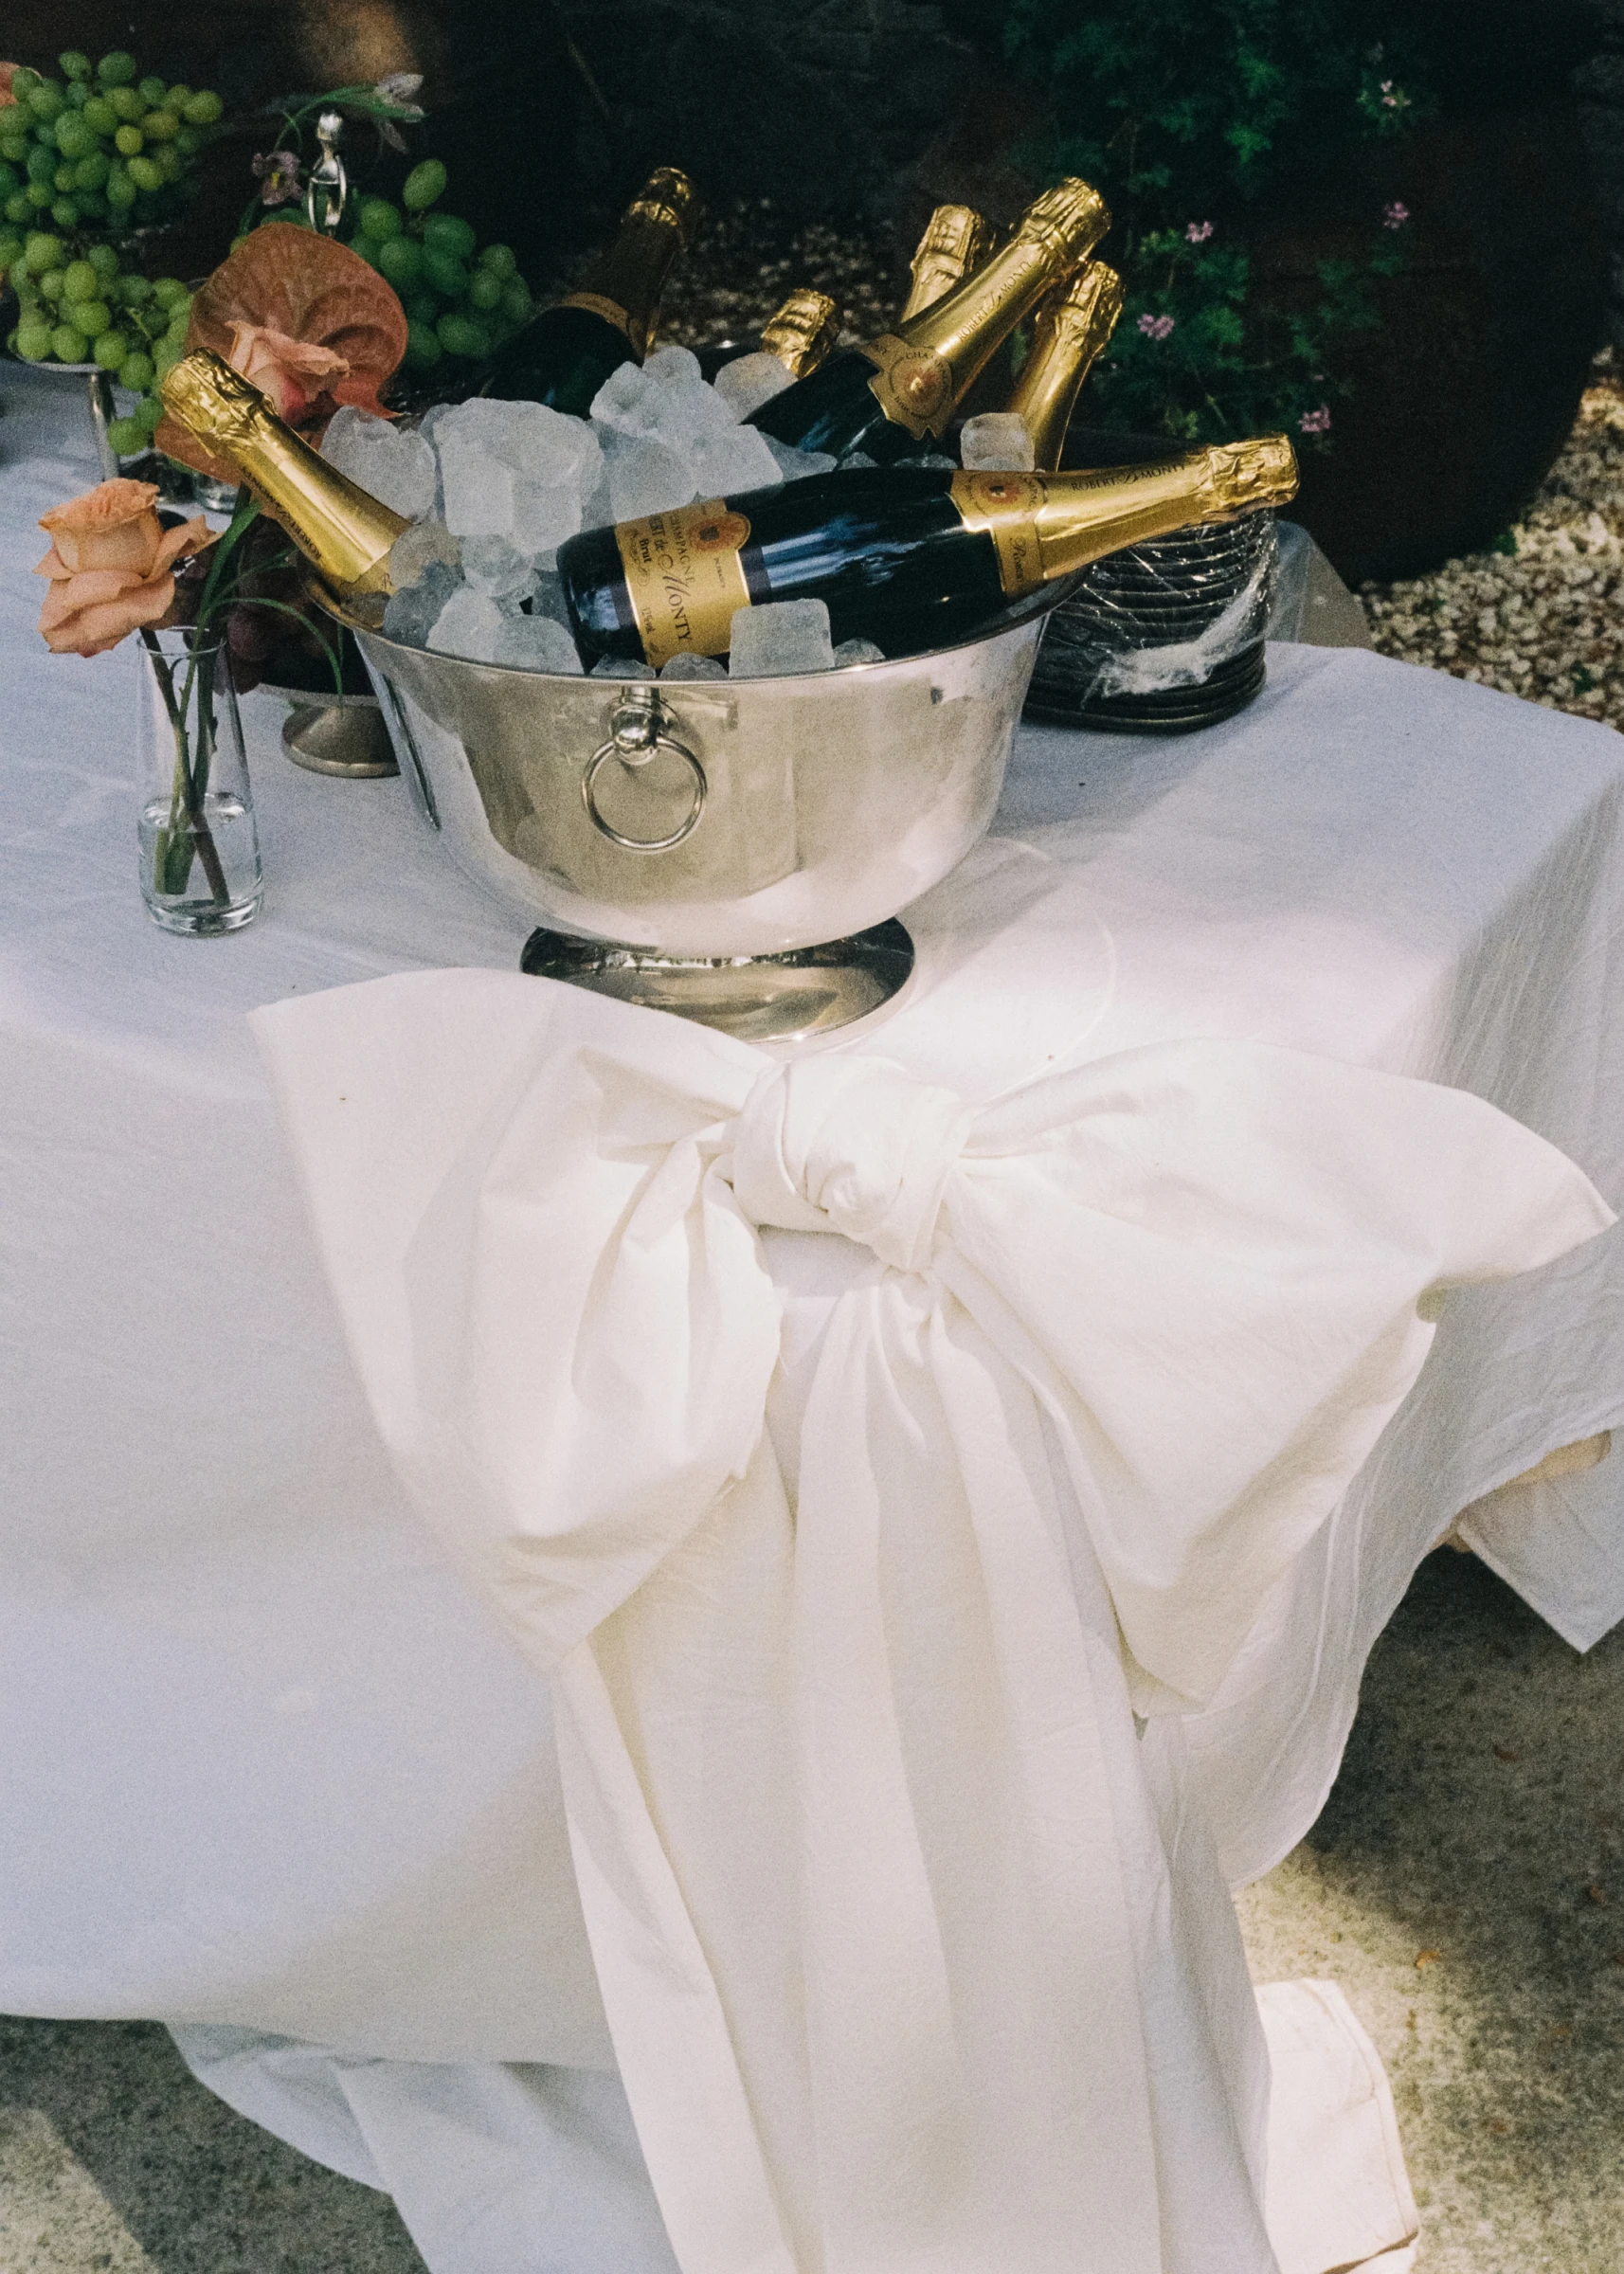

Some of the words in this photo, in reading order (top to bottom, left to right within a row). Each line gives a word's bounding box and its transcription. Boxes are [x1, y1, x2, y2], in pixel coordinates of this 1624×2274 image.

[957, 311, 988, 341] ROBERT
[1001, 261, 1033, 295] MONTY
[1071, 477, 1117, 491] ROBERT
[1139, 463, 1185, 479] MONTY
[639, 538, 652, 563] Brut
[669, 514, 695, 582] CHAMPAGNE
